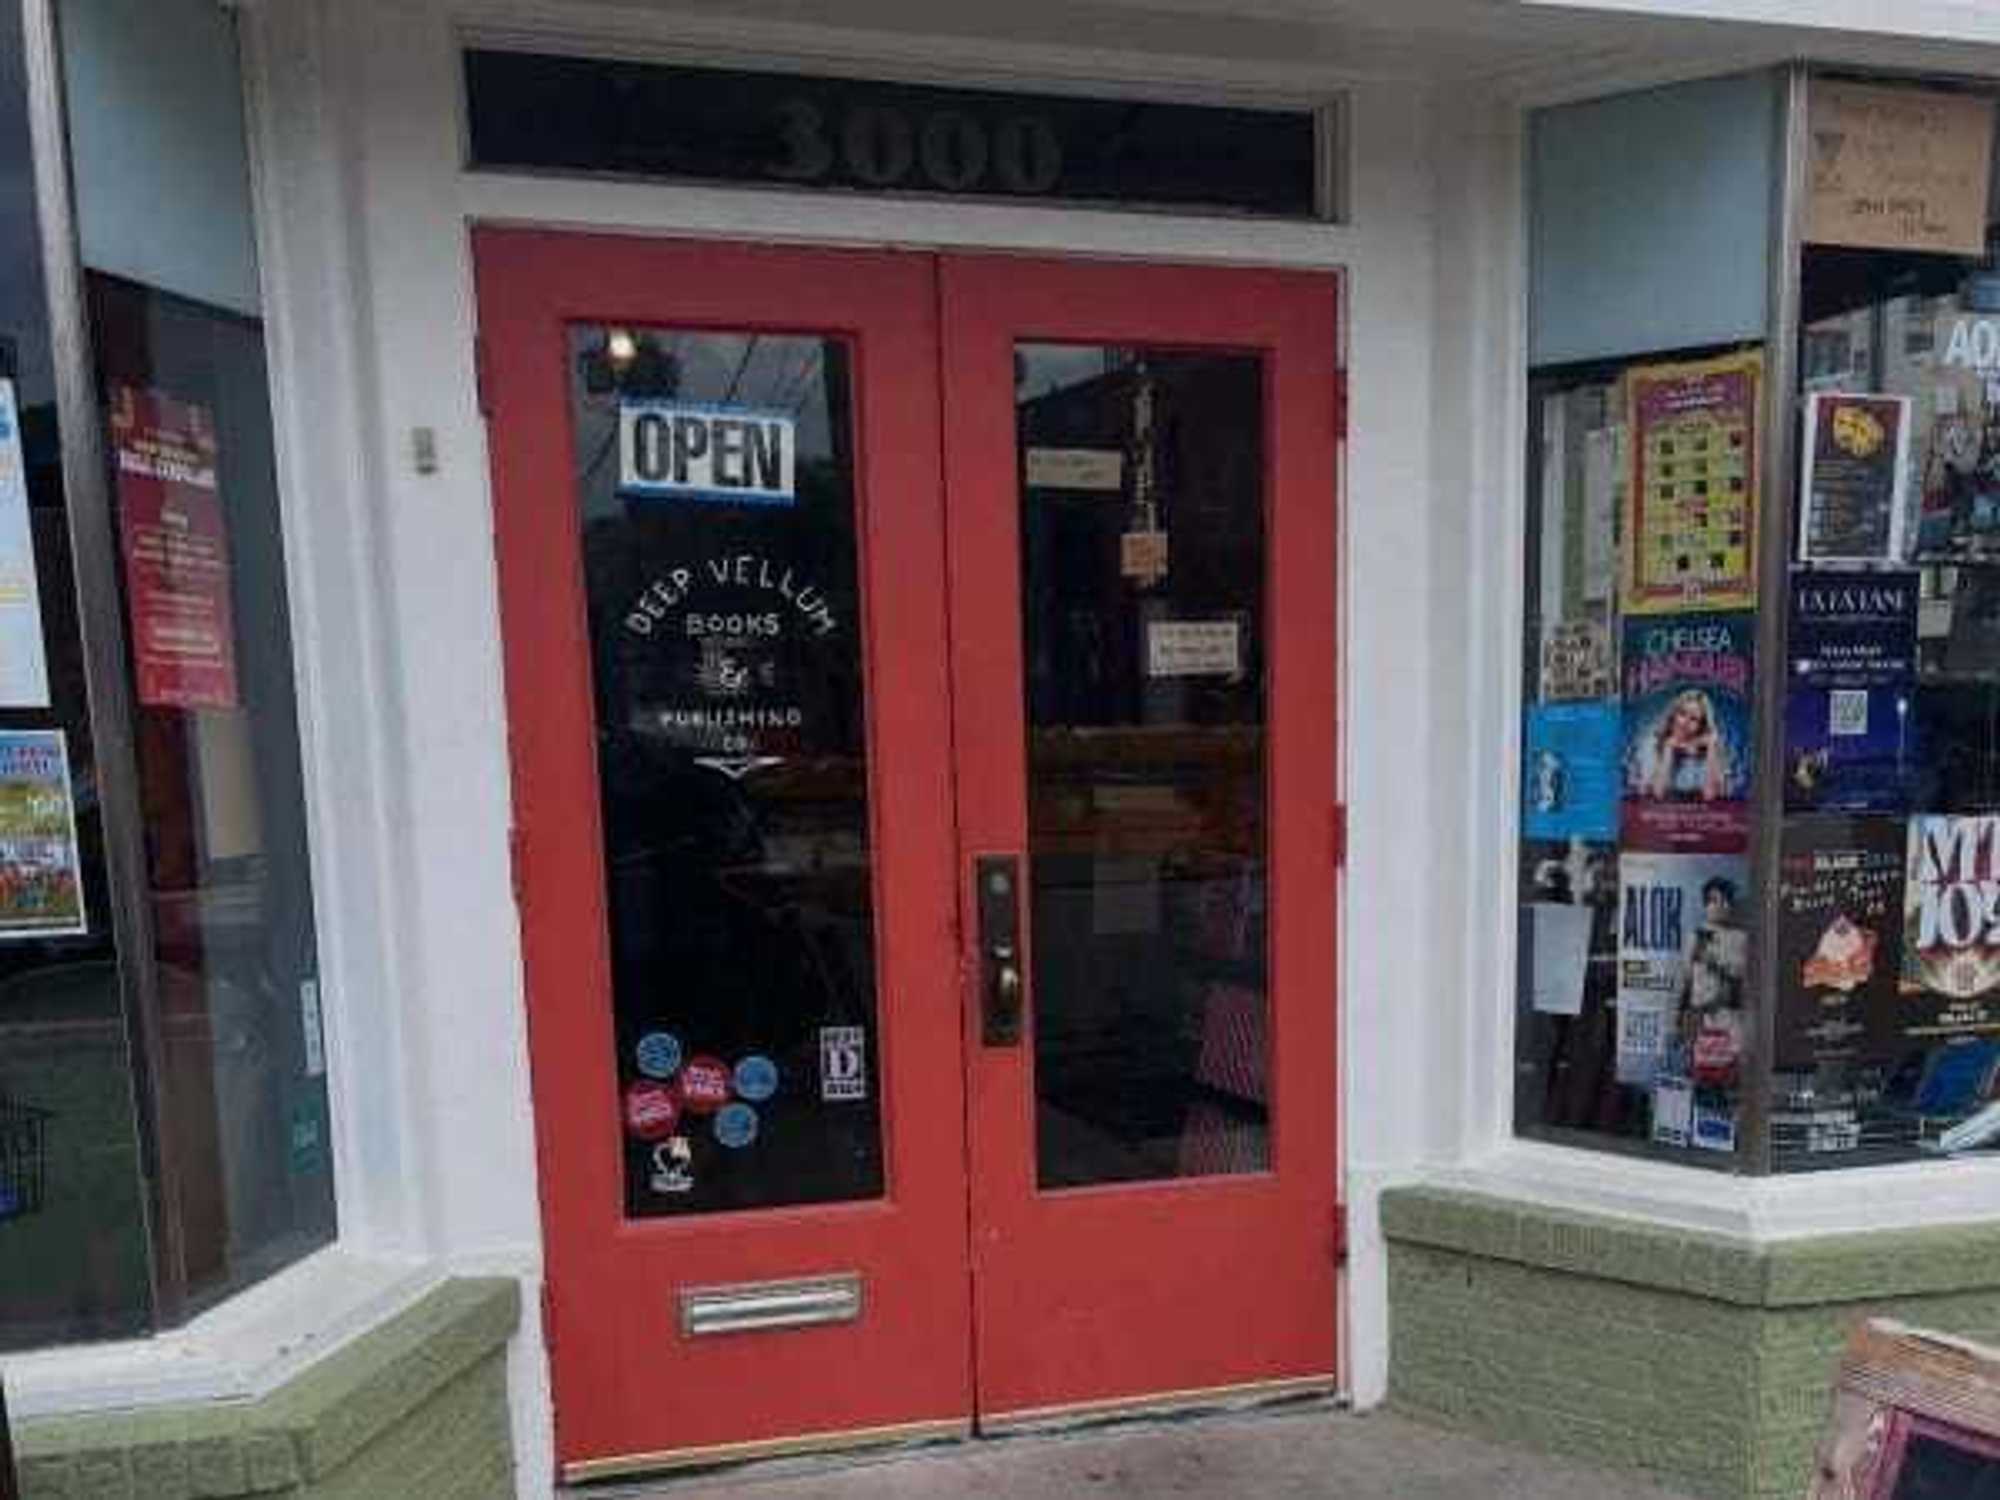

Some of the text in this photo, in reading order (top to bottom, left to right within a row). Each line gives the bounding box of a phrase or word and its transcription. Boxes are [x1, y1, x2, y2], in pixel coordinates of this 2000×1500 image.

[764, 98, 1063, 190] 3000
[634, 413, 782, 490] OPEN
[625, 555, 838, 635] DEEP VELLUM
[686, 612, 780, 636] BOOKS
[1646, 625, 1732, 653] CHELSEA
